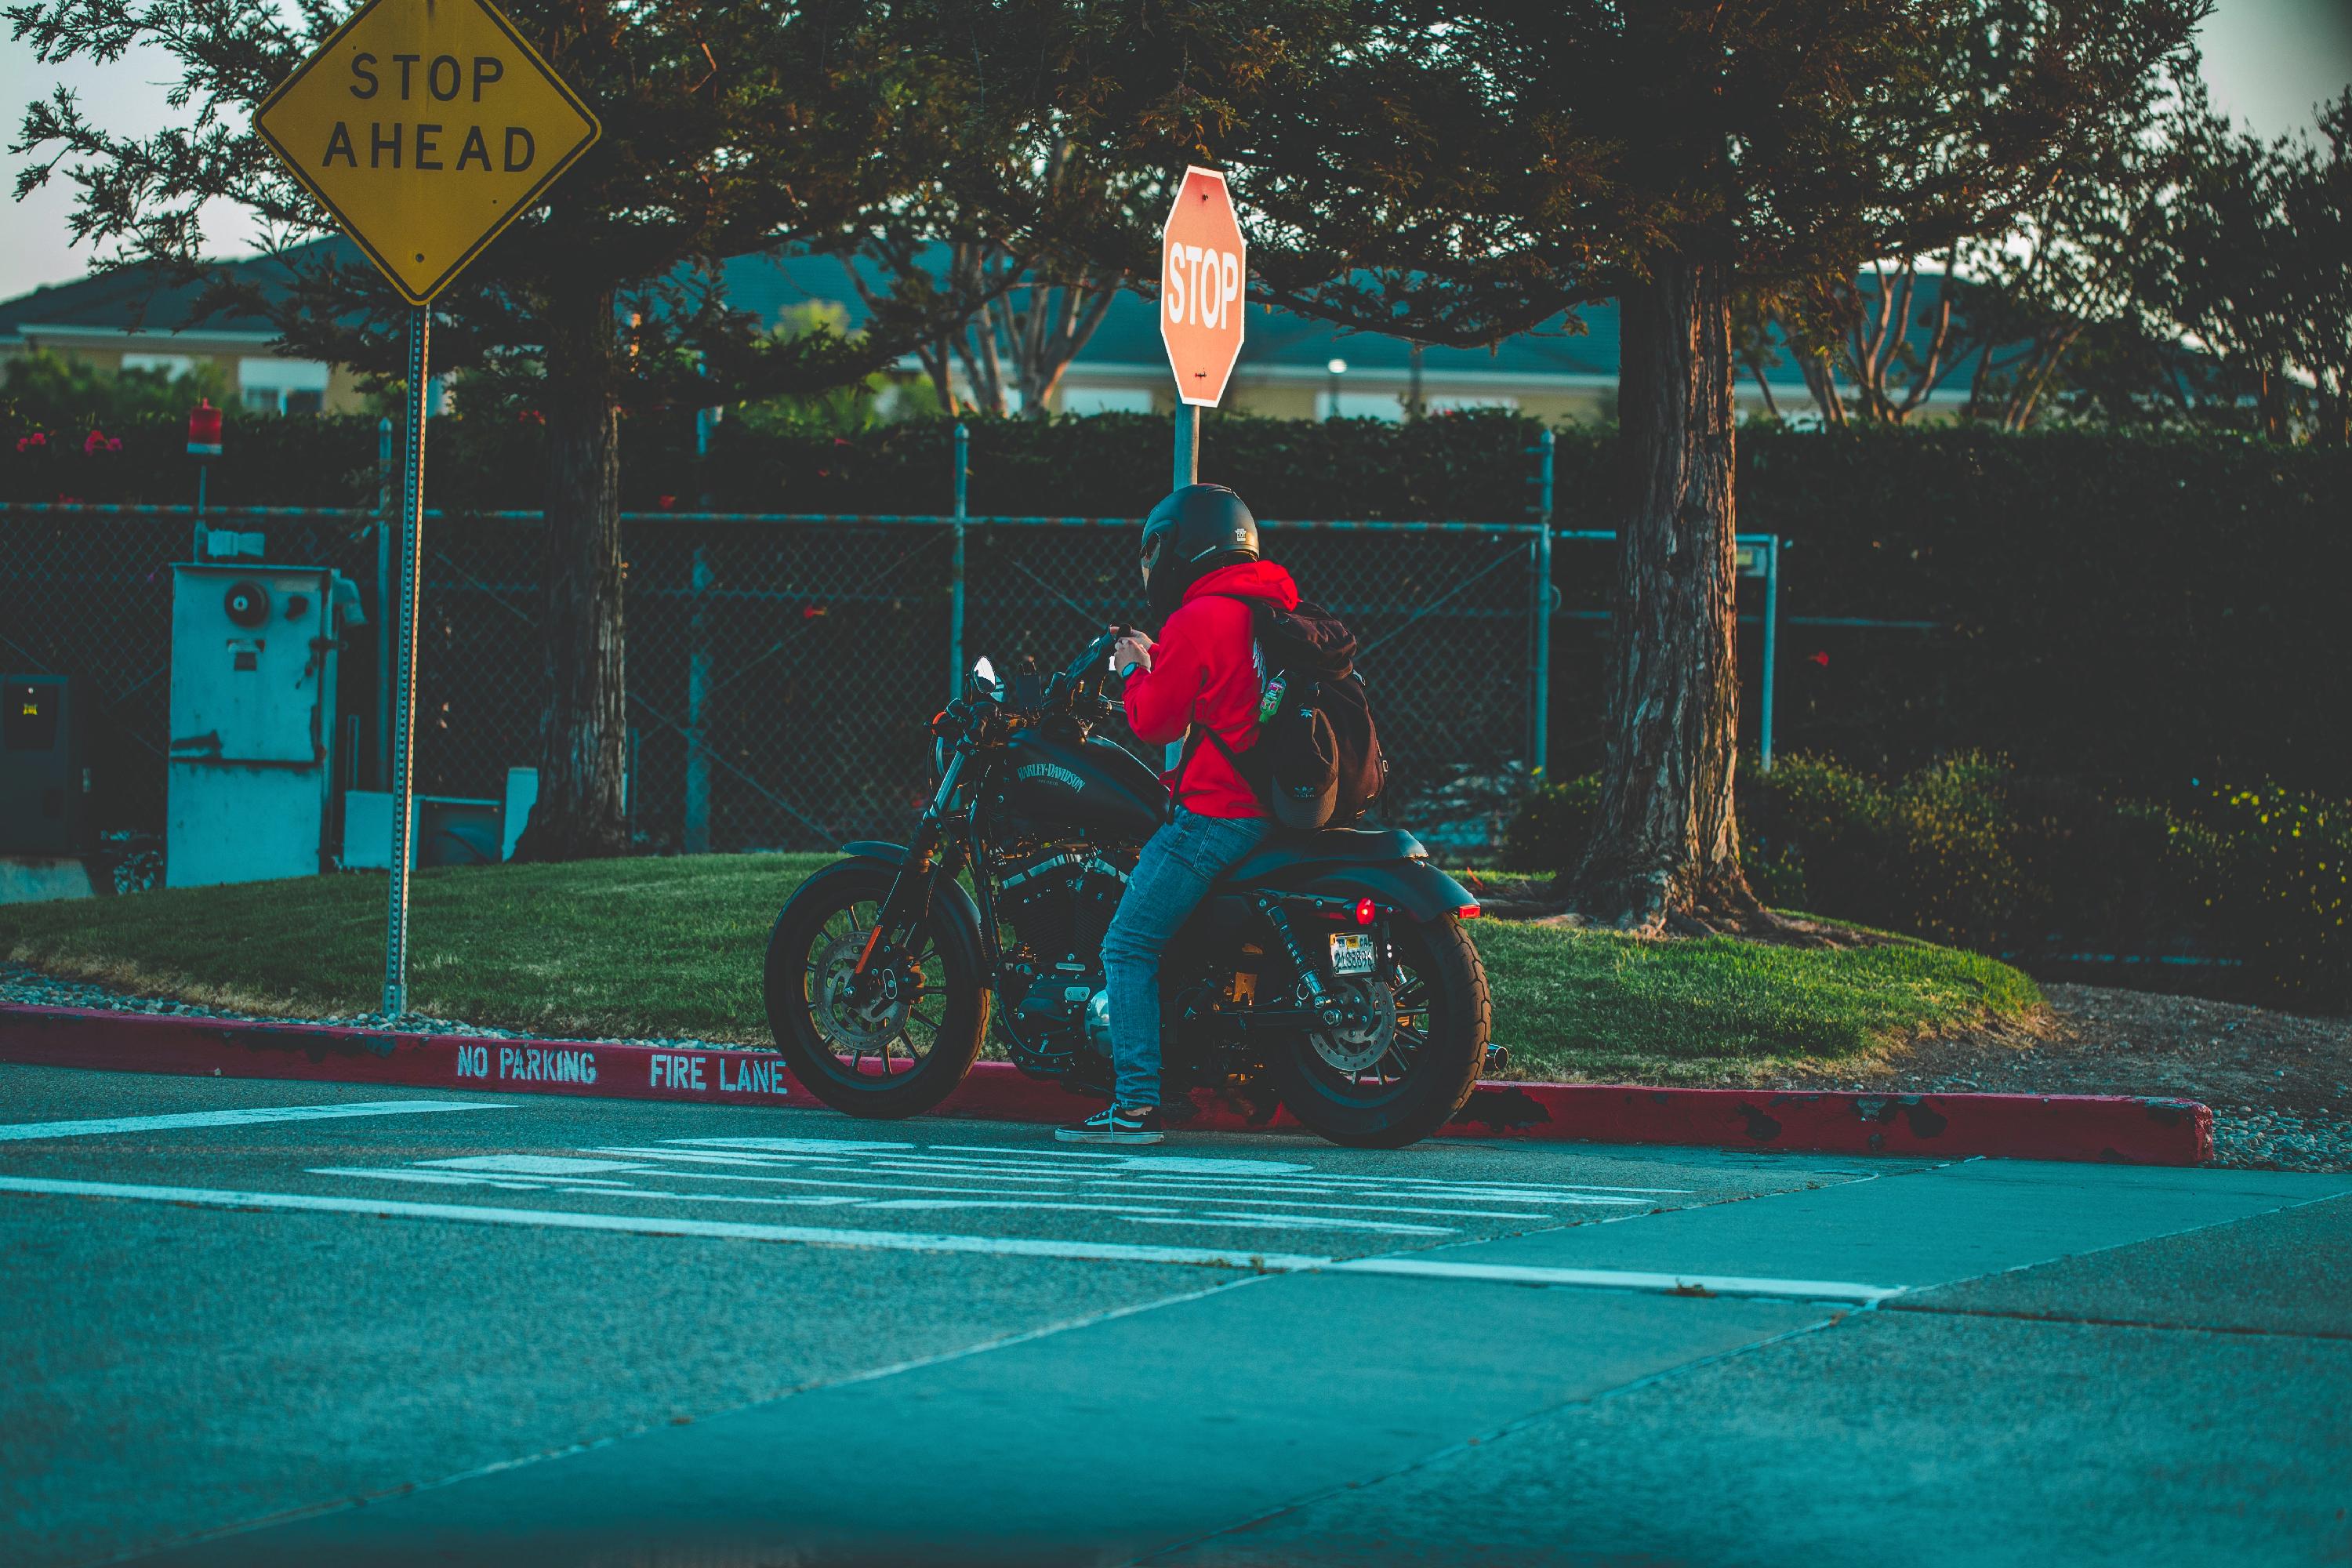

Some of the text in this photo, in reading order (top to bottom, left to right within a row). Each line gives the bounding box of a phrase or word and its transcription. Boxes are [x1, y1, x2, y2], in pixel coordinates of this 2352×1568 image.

[349, 53, 504, 103] STOP
[321, 122, 535, 172] AHEAD
[1167, 241, 1239, 330] STOP
[458, 1045, 787, 1094] NO PARKING FIRE LANE
